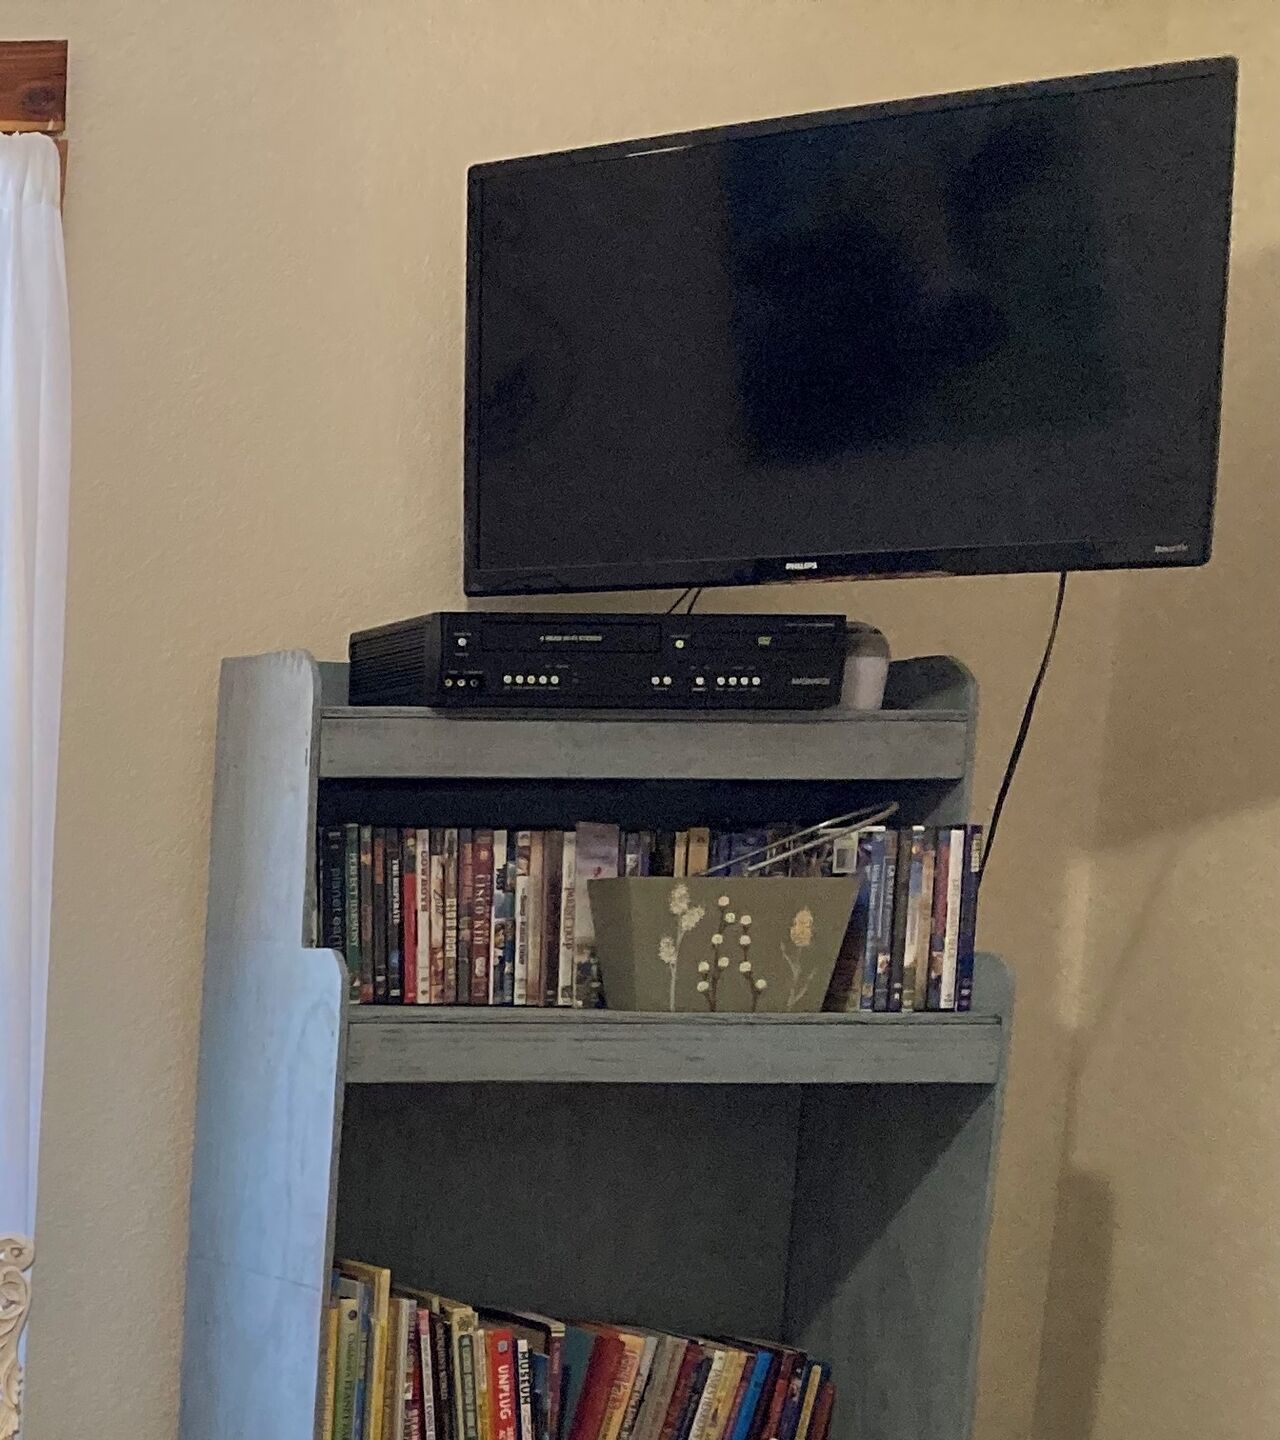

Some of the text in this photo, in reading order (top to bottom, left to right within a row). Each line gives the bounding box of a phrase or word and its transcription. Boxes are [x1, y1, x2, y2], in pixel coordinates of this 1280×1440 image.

[420, 850, 429, 912] COWBOYS
[474, 874, 486, 945] CISCO KID
[497, 1364, 512, 1420] UNPLUG
[519, 1350, 532, 1405] MUSEUM
